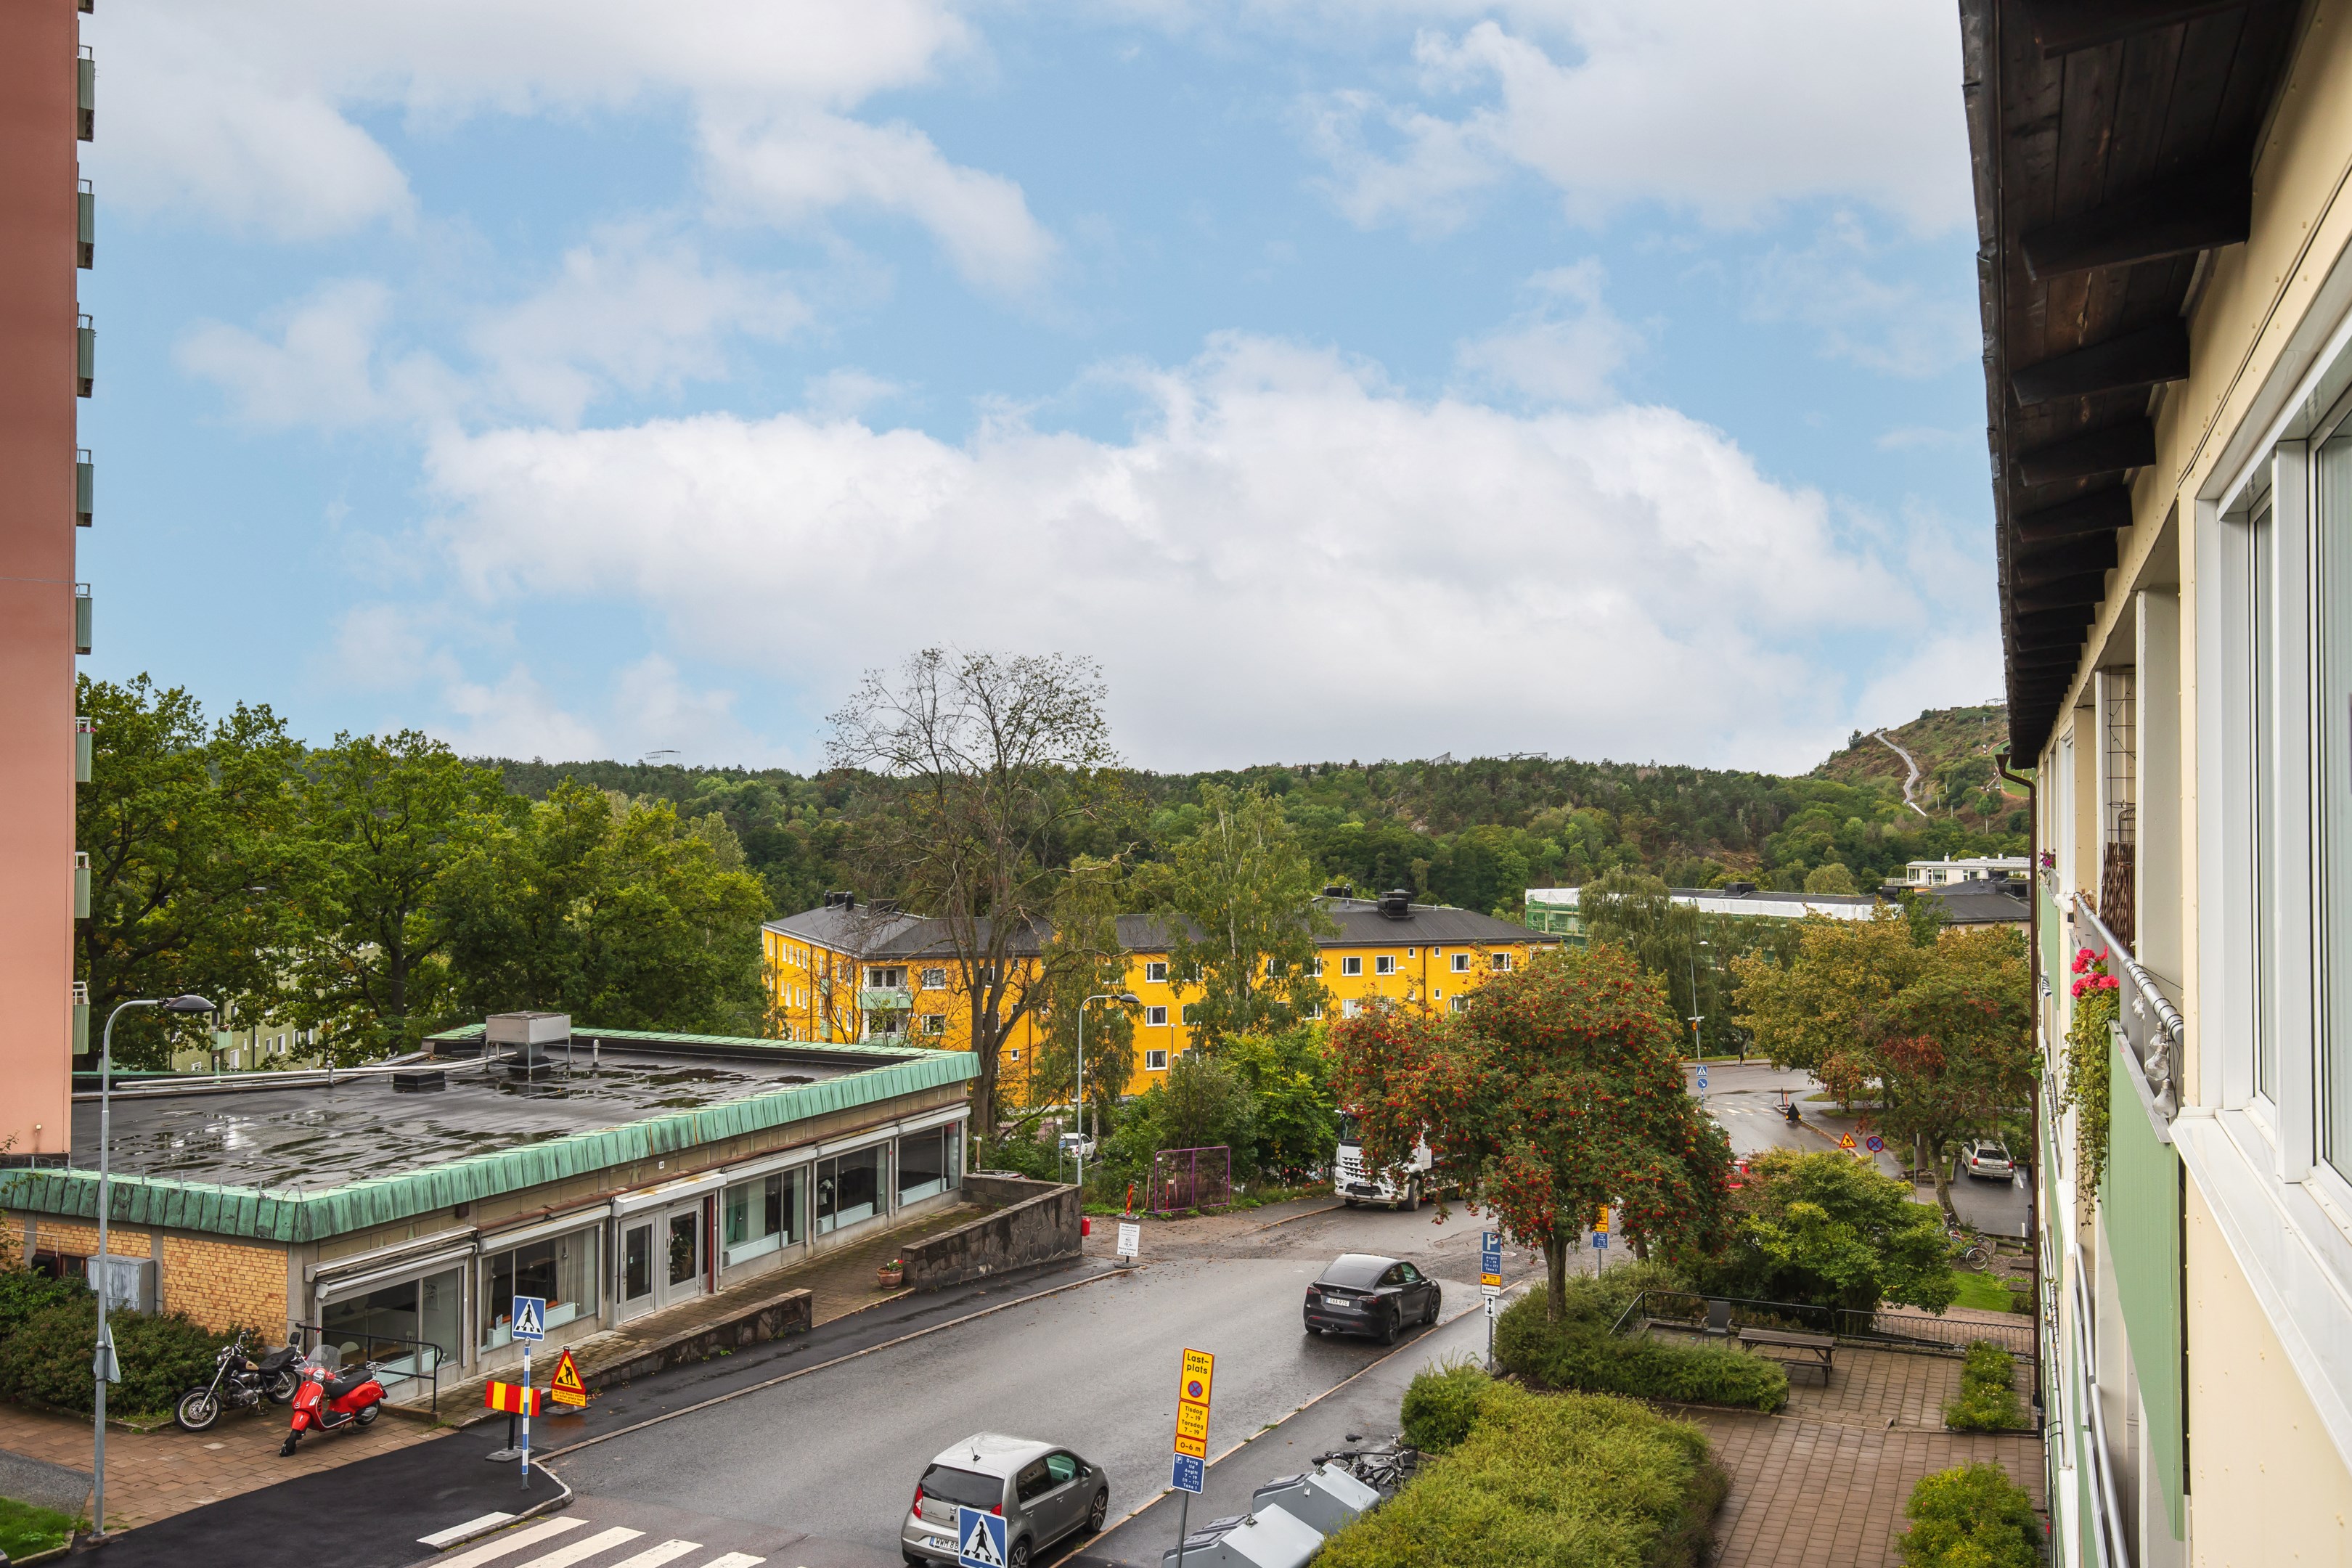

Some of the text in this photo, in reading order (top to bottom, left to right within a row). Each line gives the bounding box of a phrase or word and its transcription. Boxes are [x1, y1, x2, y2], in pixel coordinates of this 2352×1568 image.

[1487, 1234, 1498, 1250] P
[1187, 1353, 1209, 1364] Last-
[1187, 1364, 1207, 1374] plats
[1185, 1406, 1203, 1416] Tisdag
[1182, 1419, 1204, 1430] Torsdag
[1180, 1442, 1193, 1450] 0-6
[936, 1538, 949, 1547] WWM
